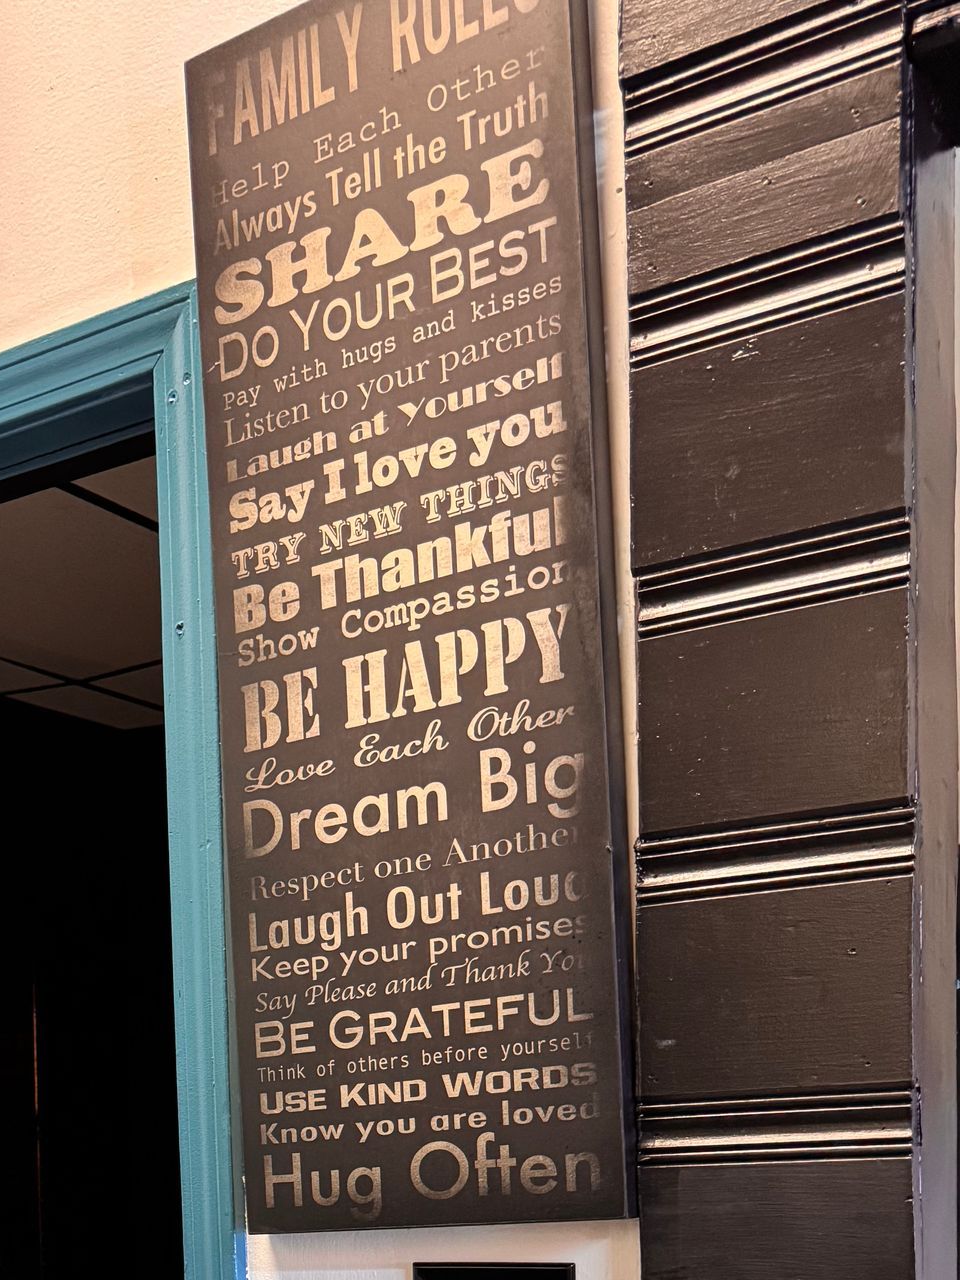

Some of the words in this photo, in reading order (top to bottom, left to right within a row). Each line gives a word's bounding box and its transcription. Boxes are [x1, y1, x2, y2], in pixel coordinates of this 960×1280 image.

[209, 3, 363, 156] FAMILY
[210, 160, 290, 206] Help
[314, 108, 401, 165] Each
[427, 46, 545, 112] Other
[213, 189, 316, 256] Always
[326, 154, 382, 206] Tell
[394, 133, 446, 180] the
[457, 82, 548, 151] Truth
[213, 138, 550, 326] SHARE
[219, 325, 279, 382] DO
[290, 274, 415, 352] YOUR
[430, 217, 557, 304] BEST
[224, 384, 260, 411] Pay
[274, 362, 328, 393] with
[342, 338, 396, 369] hugs
[413, 311, 456, 344] and
[471, 276, 562, 321] kisses
[224, 393, 310, 448] Listen
[320, 382, 348, 414] to
[357, 358, 429, 409] your
[439, 312, 562, 375] parents
[227, 428, 336, 482] Laugh
[349, 410, 390, 445] at
[398, 352, 566, 427] yourself
[229, 480, 314, 535] Say
[322, 459, 346, 504] I
[355, 438, 456, 495] love
[466, 400, 567, 467] you
[232, 532, 306, 580] TRY
[319, 501, 406, 555] NEW
[420, 454, 570, 523] THINGS
[233, 580, 300, 634] Be
[311, 495, 567, 610] Thankful
[239, 626, 320, 668] Show
[241, 667, 321, 753] BE
[342, 604, 570, 729] HAPPY
[243, 781, 448, 860] Dream
[480, 741, 585, 818] Big
[245, 757, 335, 793] Love
[354, 719, 449, 768] Each
[467, 698, 576, 743] Other
[249, 891, 369, 953] Laugh
[386, 882, 462, 930] Out
[250, 861, 365, 902] Respect
[374, 849, 432, 880] one
[250, 954, 329, 982] Keep
[340, 937, 416, 977] your
[429, 913, 586, 963] promises
[255, 993, 297, 1020] Say
[304, 980, 377, 1008] Please
[385, 962, 436, 996] and
[441, 950, 532, 988] Thank
[254, 1020, 316, 1059] BE
[329, 988, 595, 1051] GRATEFUL
[257, 1063, 306, 1083] Think
[317, 1058, 335, 1078] of
[347, 1049, 409, 1074] others
[422, 1040, 488, 1067] before
[501, 1031, 594, 1060] yourself
[260, 1088, 327, 1115] USE
[340, 1076, 427, 1109] KIND
[442, 1062, 599, 1098] WORDS
[260, 1122, 344, 1145] Know
[355, 1115, 416, 1144] you
[430, 1107, 487, 1132] are
[502, 1096, 600, 1127] loved
[263, 1152, 382, 1220] Hug
[410, 1131, 603, 1200] Often
